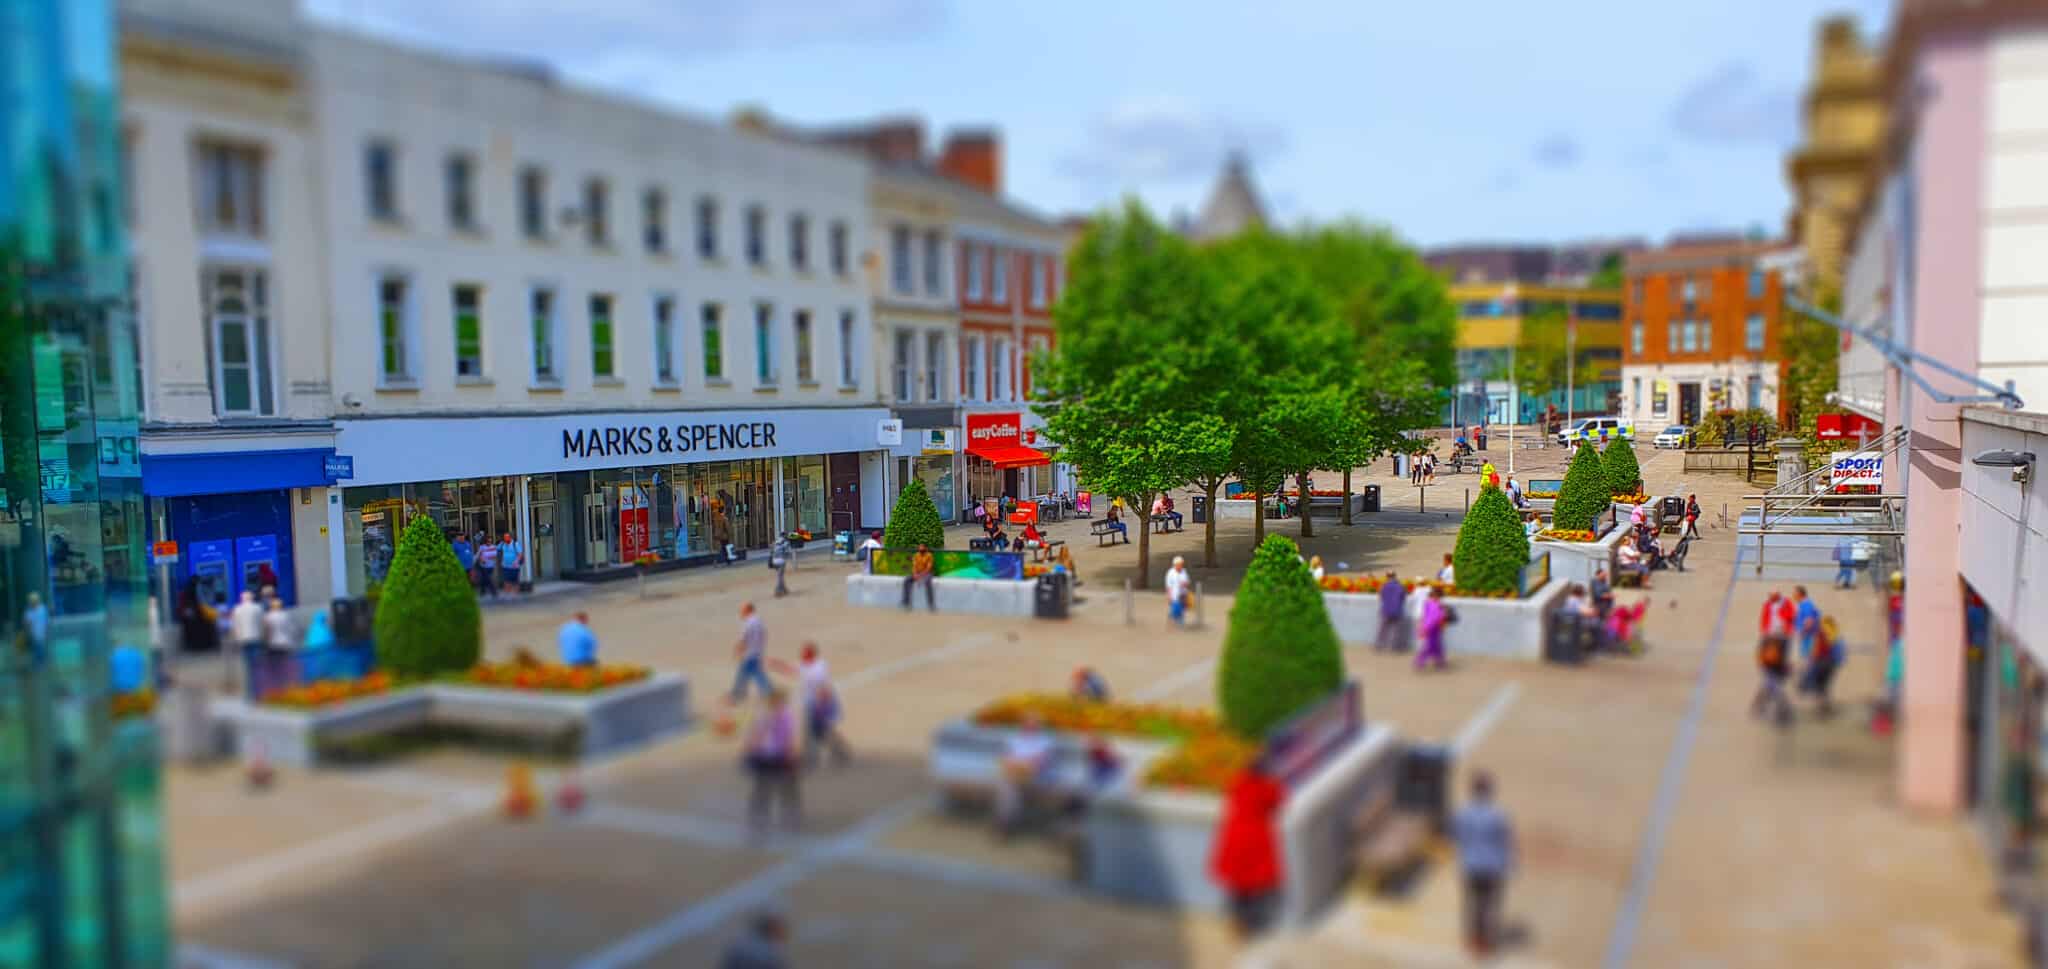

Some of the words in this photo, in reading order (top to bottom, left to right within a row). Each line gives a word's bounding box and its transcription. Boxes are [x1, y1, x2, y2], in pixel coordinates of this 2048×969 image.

[563, 426, 652, 459] MARKS
[657, 427, 673, 453] &
[677, 422, 777, 451] SPENCER
[972, 423, 1017, 440] easyCoffee
